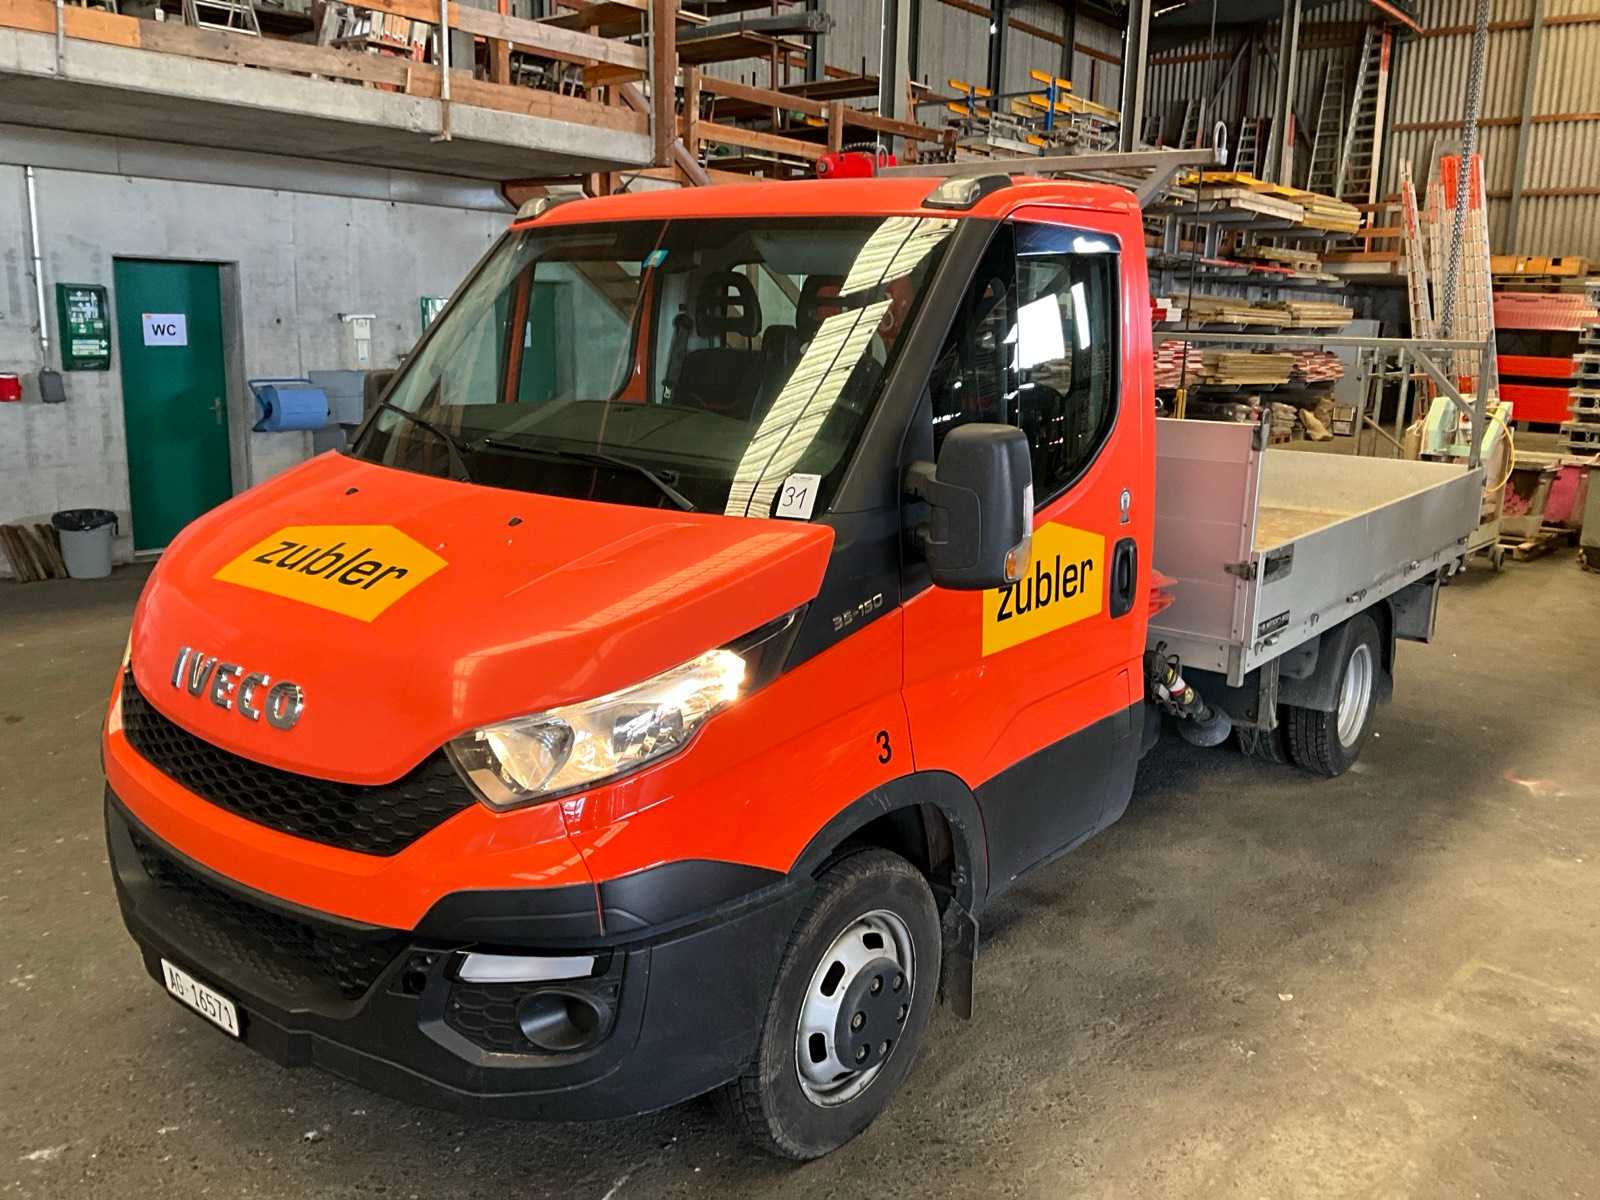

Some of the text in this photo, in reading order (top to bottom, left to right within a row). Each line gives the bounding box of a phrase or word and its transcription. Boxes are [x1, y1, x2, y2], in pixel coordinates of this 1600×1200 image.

[151, 324, 177, 336] WC
[783, 486, 807, 509] 31
[253, 540, 408, 590] zubler
[997, 554, 1093, 622] zubler
[832, 593, 883, 631] 35-150
[171, 646, 304, 731] IVECO
[876, 730, 892, 764] 3
[191, 983, 233, 1029] 16571
